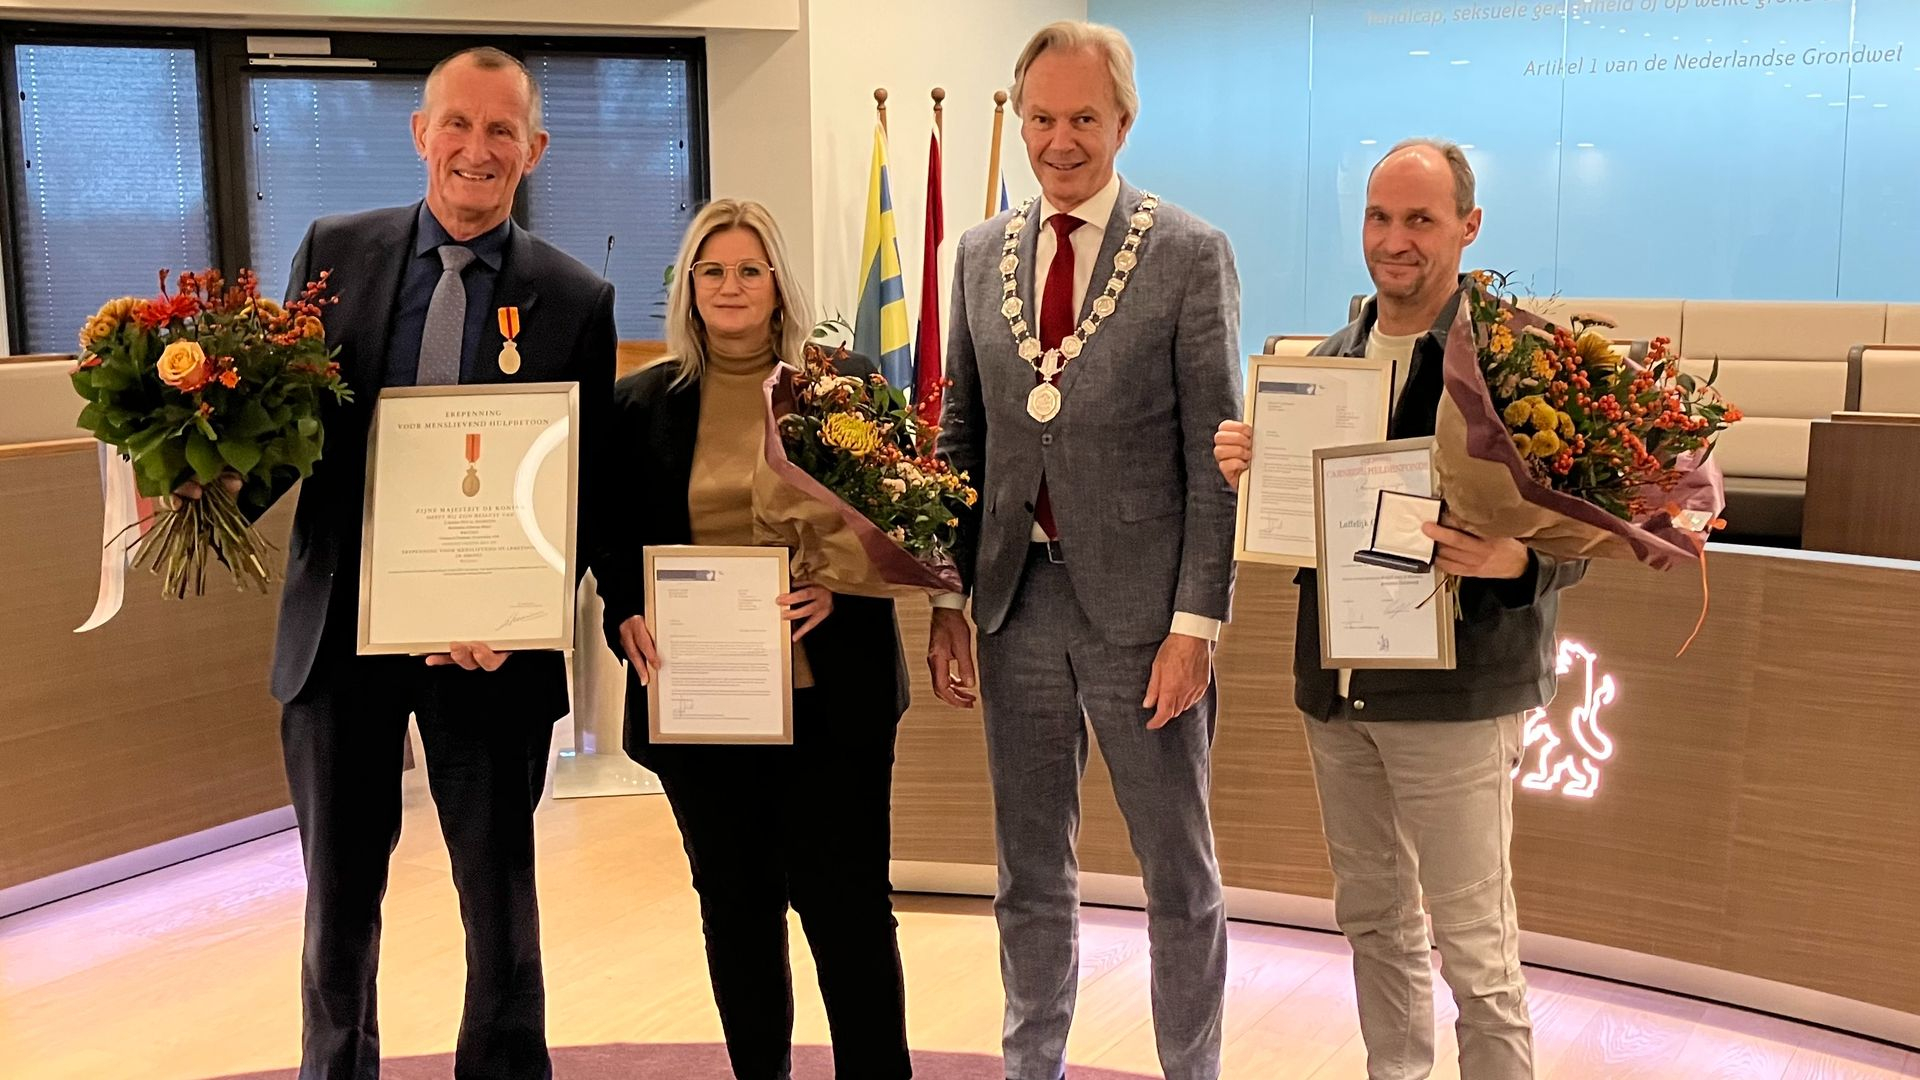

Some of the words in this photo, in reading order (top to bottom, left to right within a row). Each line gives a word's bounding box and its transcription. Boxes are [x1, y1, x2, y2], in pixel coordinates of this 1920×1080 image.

[1452, 1, 1527, 21] seksuele
[1665, 0, 1689, 13] op
[1523, 57, 1584, 77] Artikel
[1588, 58, 1598, 74] 1
[1605, 59, 1638, 73] van
[1644, 54, 1668, 71] de
[1674, 48, 1796, 70] Nederlandse
[1802, 44, 1904, 65] Grondwet
[445, 410, 502, 418] EREPENNING
[398, 422, 421, 430] VOOR
[424, 420, 487, 429] MENSLIEVEND
